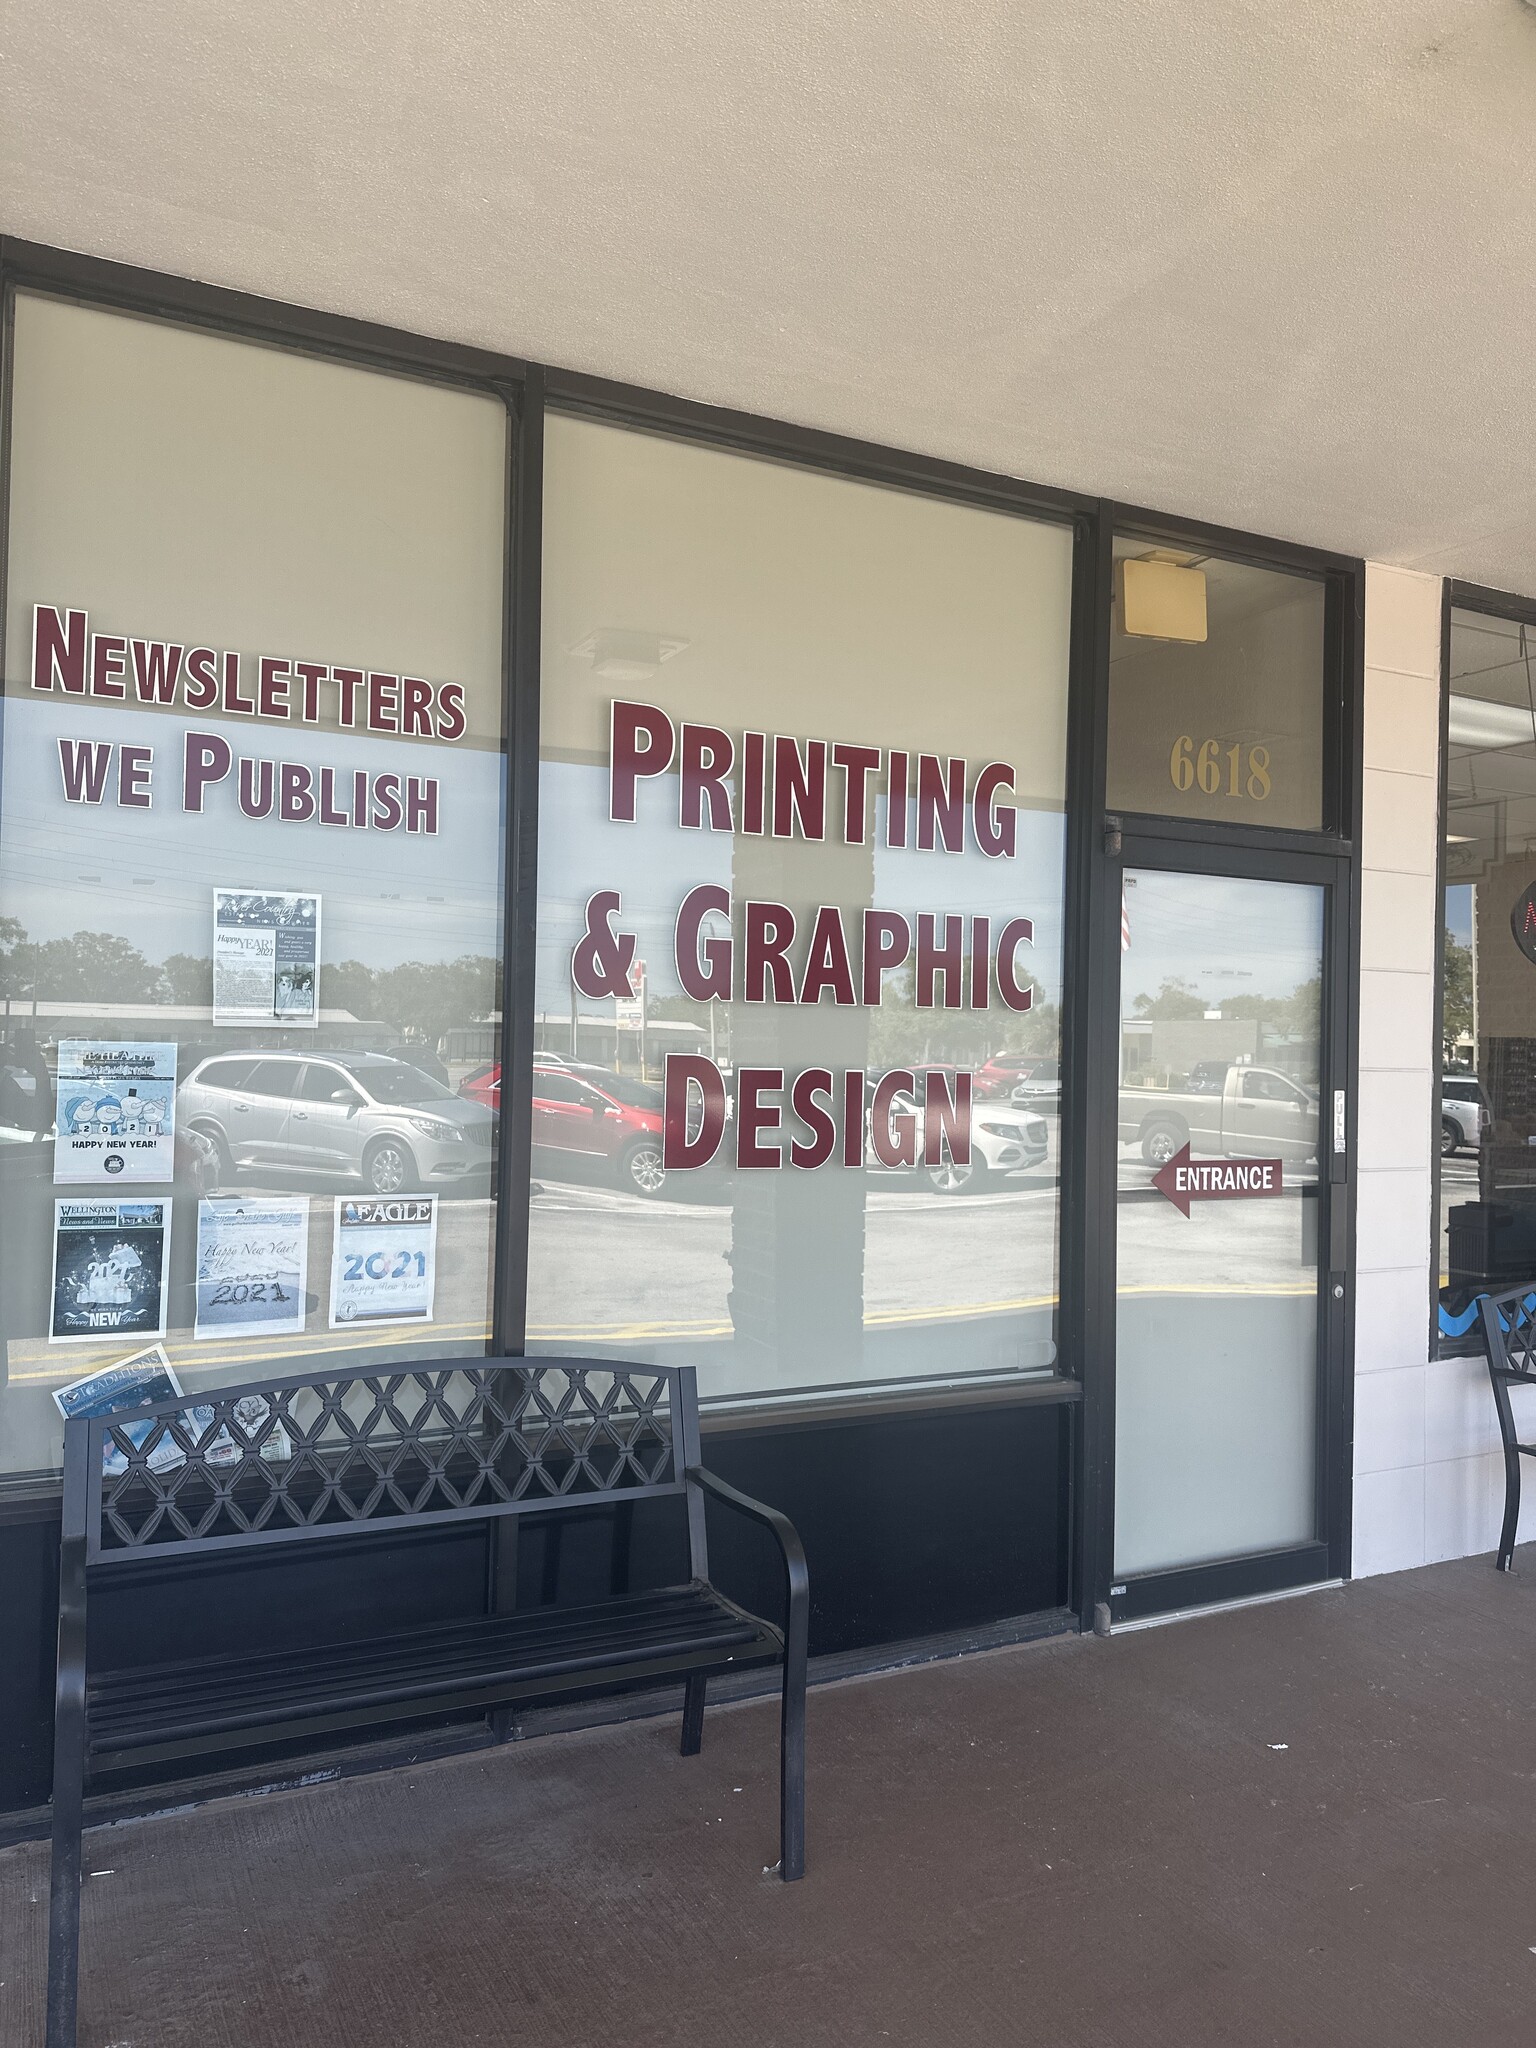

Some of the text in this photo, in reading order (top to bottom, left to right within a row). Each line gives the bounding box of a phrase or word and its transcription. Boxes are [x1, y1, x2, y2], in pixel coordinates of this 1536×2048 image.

[31, 603, 467, 740] NEWSLETTERS
[608, 698, 1018, 859] PRINTING
[1170, 735, 1271, 800] 6618
[55, 730, 440, 836] WE PUBLISH
[217, 934, 241, 944] Happy
[239, 938, 273, 949] YEAR!
[572, 889, 637, 1000] &
[674, 883, 1035, 1012] GRAPHIC
[662, 1053, 973, 1171] DESIGN
[1335, 1091, 1344, 1139] PULL
[72, 1140, 157, 1149] HAPPY NEW YEAR!
[1175, 1166, 1274, 1191] ENTRANCE
[60, 1205, 117, 1216] WELLINGTON
[356, 1202, 431, 1222] EAGLE
[204, 1241, 297, 1266] Happy New Year!
[343, 1250, 426, 1281] 2021
[88, 1259, 129, 1280] 2021
[209, 1282, 291, 1306] 2021
[89, 1311, 122, 1327] NEW
[77, 1354, 159, 1397] TRADITIONS
